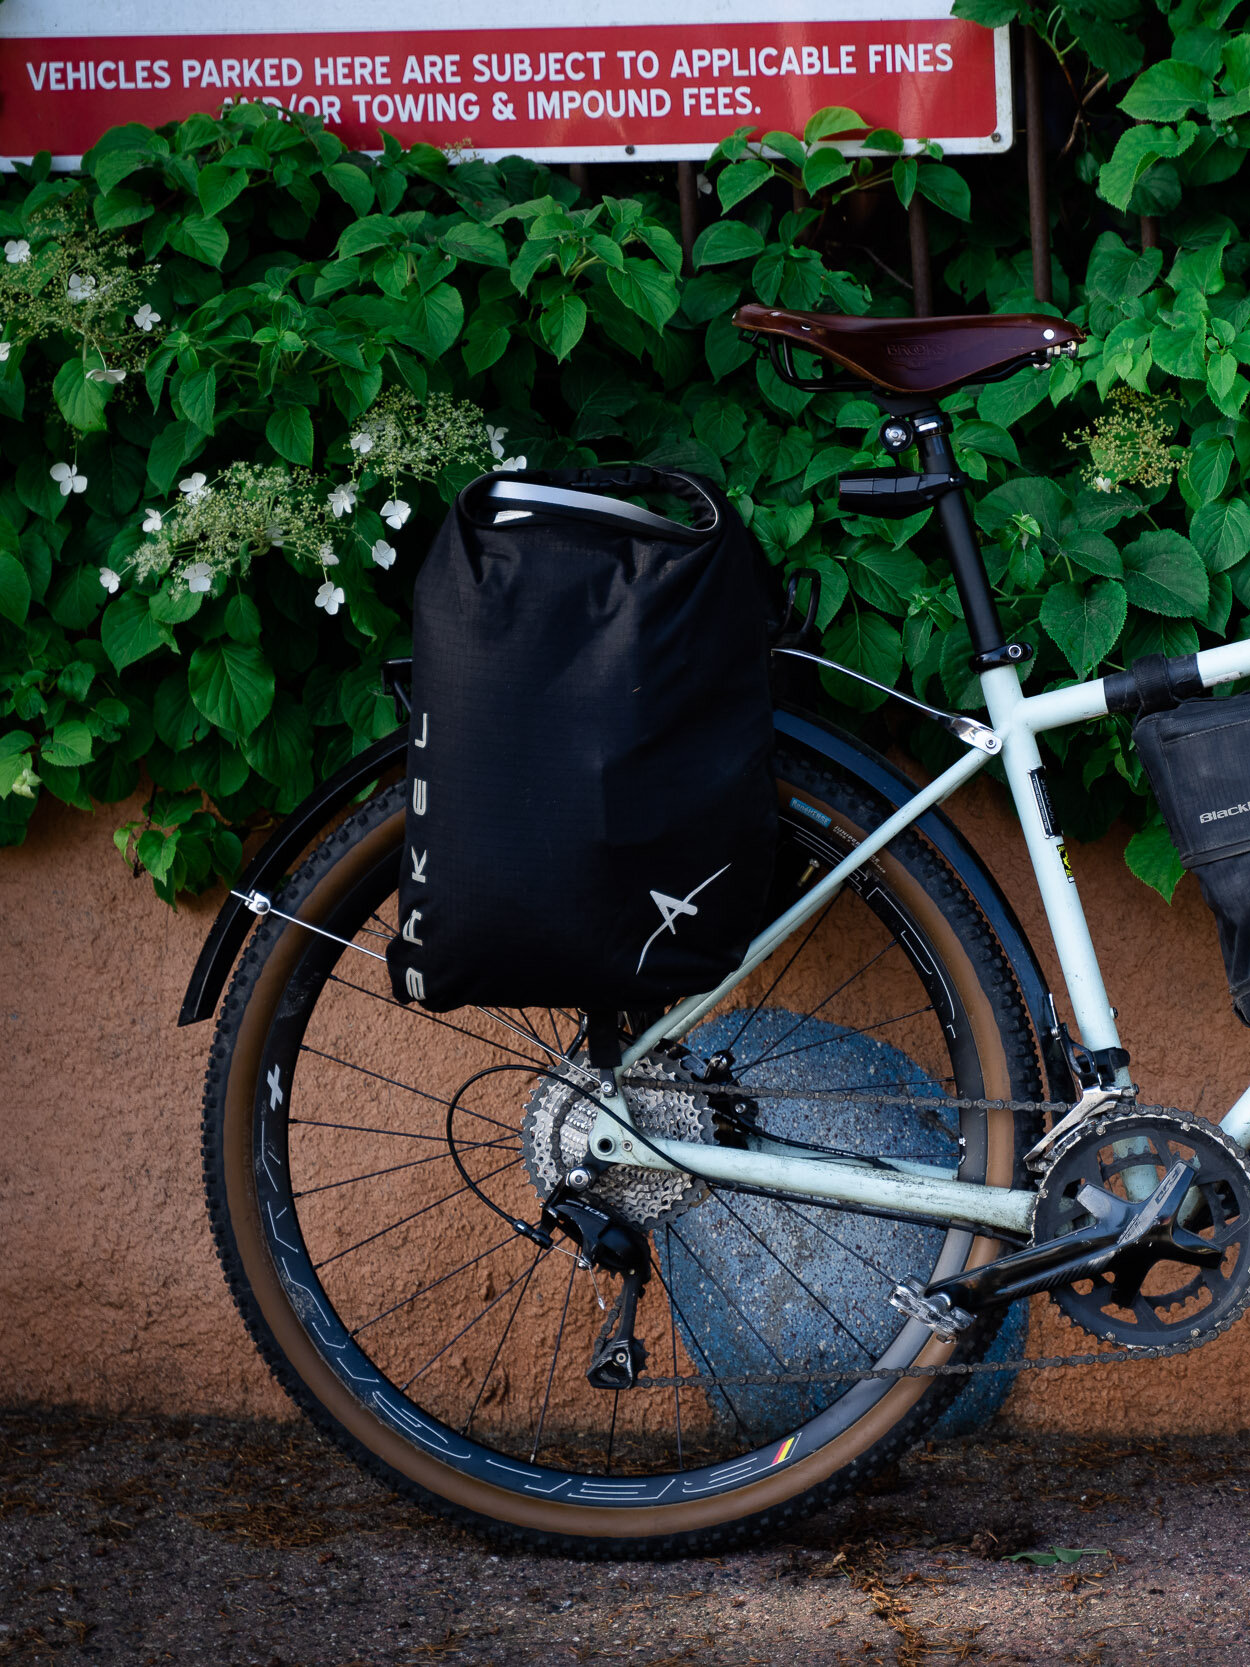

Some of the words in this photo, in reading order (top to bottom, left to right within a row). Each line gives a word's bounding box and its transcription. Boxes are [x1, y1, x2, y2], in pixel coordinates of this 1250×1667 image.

[26, 60, 170, 91] VEHICLES
[182, 57, 303, 87] PARKED
[315, 55, 391, 85] HERE
[402, 54, 462, 84] ARE
[473, 51, 606, 82] SUBJECT
[617, 49, 660, 79] TO
[671, 45, 856, 77] APPLICABLE
[868, 43, 953, 73] FINES
[220, 93, 341, 124] D/OR
[352, 92, 480, 123] TOWING
[491, 91, 517, 120] &
[527, 87, 671, 120] IMPOUND
[683, 86, 762, 117] FEES.
[887, 344, 947, 355] BROOKS
[583, 1204, 610, 1221] 105
